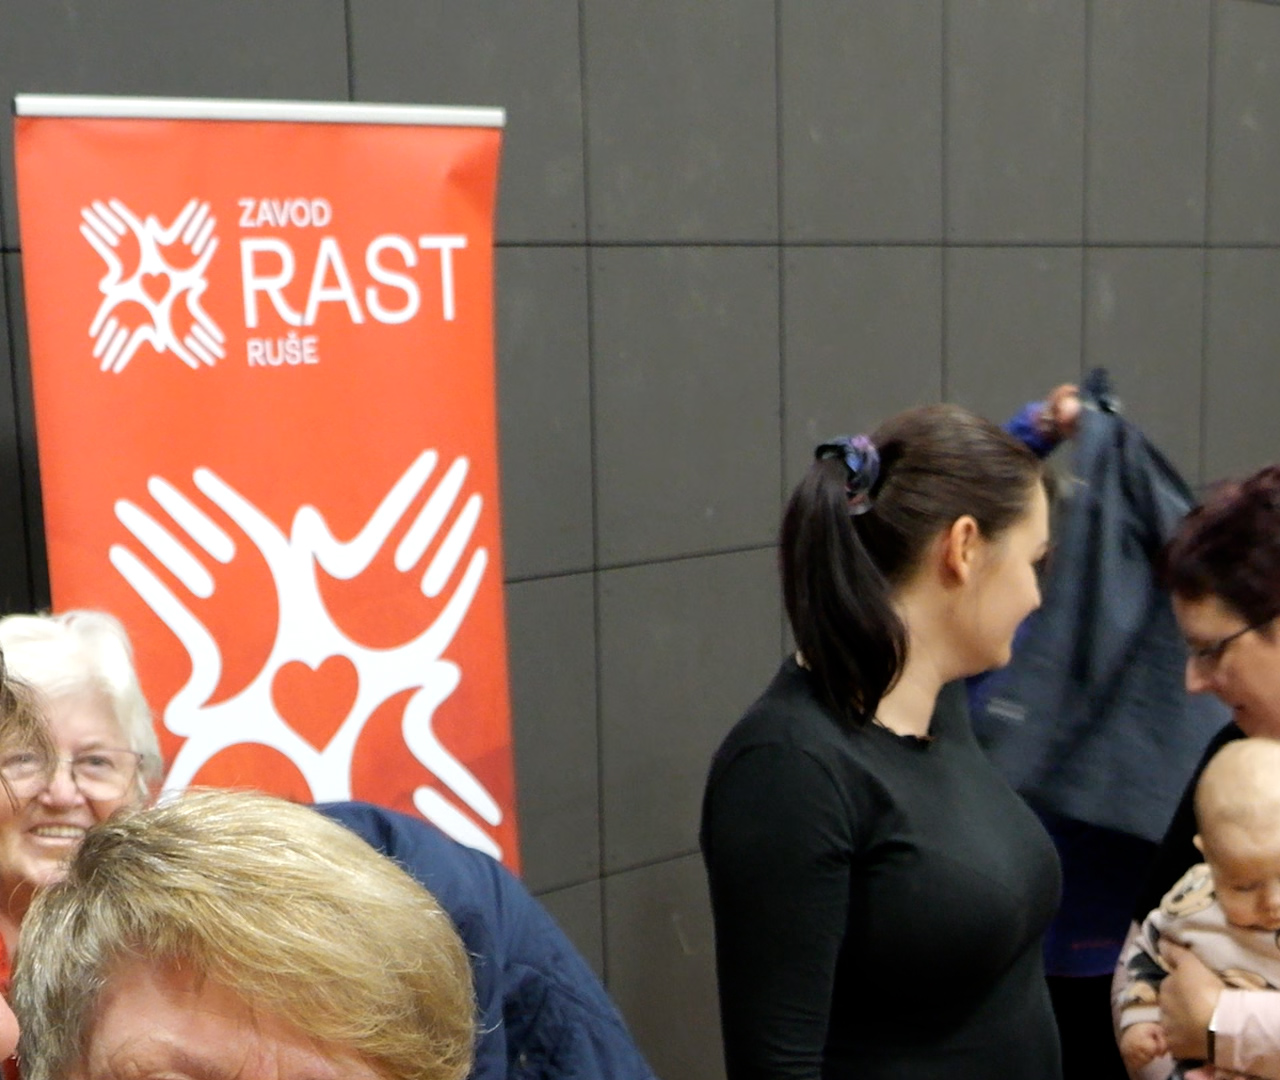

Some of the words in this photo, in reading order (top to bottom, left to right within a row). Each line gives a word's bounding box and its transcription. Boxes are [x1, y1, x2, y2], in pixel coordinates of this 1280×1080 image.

[238, 198, 331, 228] ZAVOD
[240, 235, 467, 328] RAST
[246, 332, 318, 367] RUŠE
